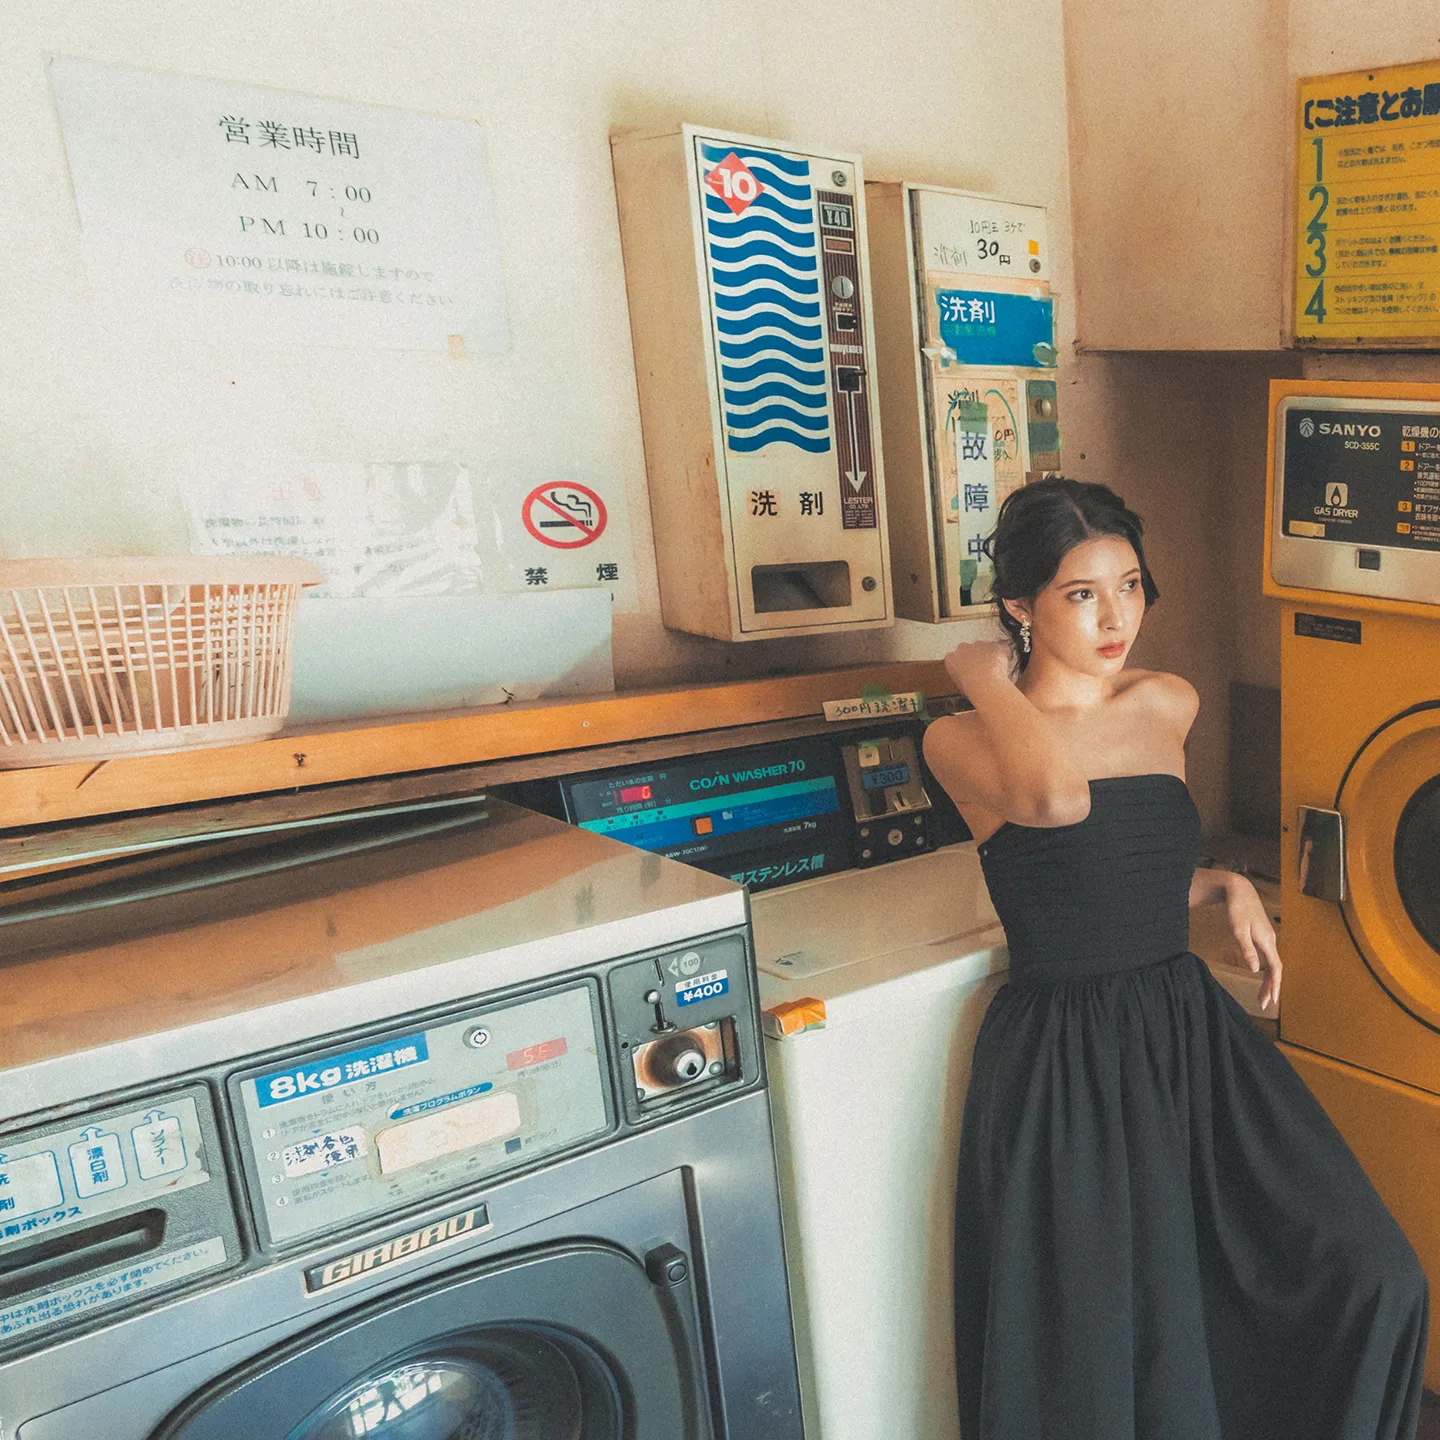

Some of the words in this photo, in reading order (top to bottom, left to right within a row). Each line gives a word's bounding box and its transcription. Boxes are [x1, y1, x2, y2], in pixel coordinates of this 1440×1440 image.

[218, 115, 361, 159] 営業時間
[1312, 138, 1324, 182] 1
[231, 172, 279, 194] AM
[718, 168, 758, 202] 10
[1306, 185, 1329, 231] 2
[239, 215, 286, 236] PM
[1305, 231, 1327, 277] 3
[941, 295, 995, 323] 洗剤
[1304, 279, 1327, 324] 4
[1319, 422, 1381, 437] SANYO
[751, 490, 824, 517] 洗剤
[961, 432, 990, 562] 故障中
[1314, 507, 1331, 517] GAS
[1332, 507, 1359, 518] DRYER
[732, 764, 788, 783] WASHER
[788, 759, 806, 773] 70
[871, 770, 903, 785] ¥300
[684, 973, 718, 988] 使用料金
[684, 982, 723, 1002] ¥400
[270, 1067, 341, 1099] 8kg
[345, 1045, 418, 1079] 洗濯機
[322, 1082, 376, 1104] 使い方
[403, 1086, 481, 1116] 洗濯プログラムボタン
[87, 1146, 109, 1184] 漂白剤
[0, 1206, 82, 1239] 剤ボックス
